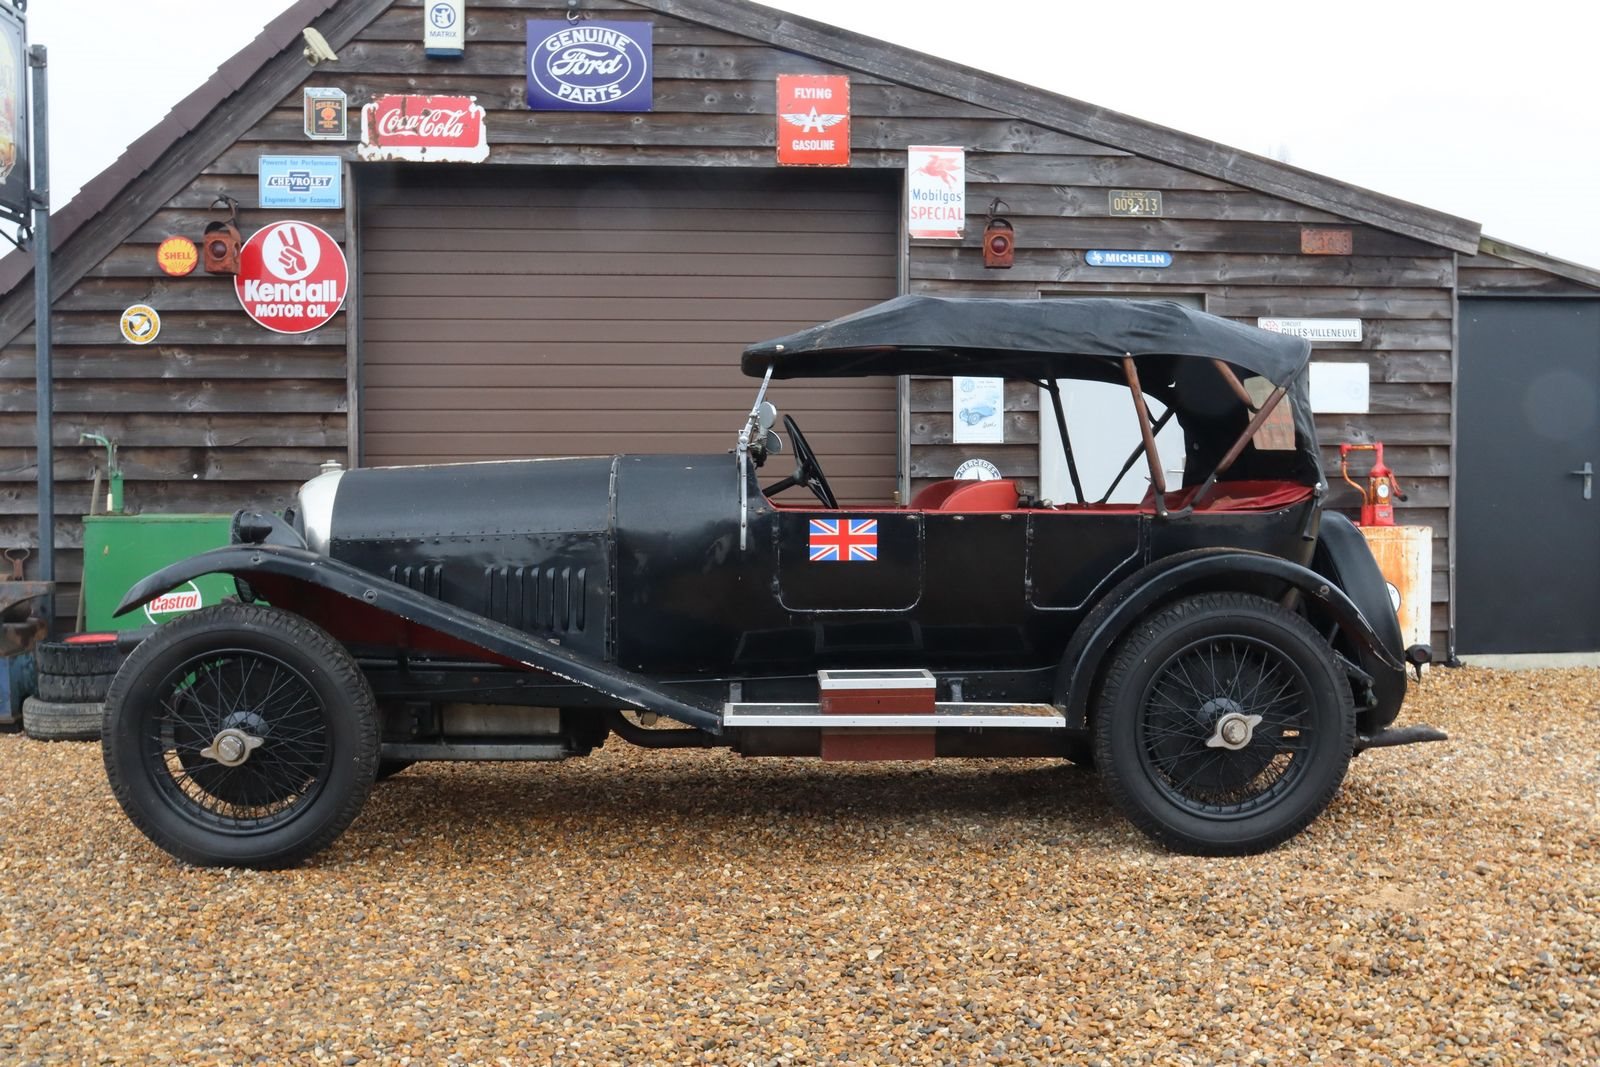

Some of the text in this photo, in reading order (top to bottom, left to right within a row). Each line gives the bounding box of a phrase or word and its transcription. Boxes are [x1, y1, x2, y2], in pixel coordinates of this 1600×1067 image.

[545, 30, 631, 52] GENUINE
[551, 48, 624, 76] Ford
[557, 84, 622, 103] PARTS
[794, 88, 833, 100] FLYING
[377, 108, 468, 138] Coca-Cola
[792, 140, 835, 151] GASOLINE
[270, 176, 329, 187] CHEVROLET
[264, 196, 296, 204] Engineered
[310, 196, 336, 205] Economy
[911, 206, 963, 221] SPECIAL
[164, 251, 192, 260] SHELL
[1105, 253, 1165, 264] MICHELIN
[255, 304, 329, 318] MOTOR OIL
[958, 460, 997, 474] MERCEDES
[151, 594, 197, 611] Castrol
